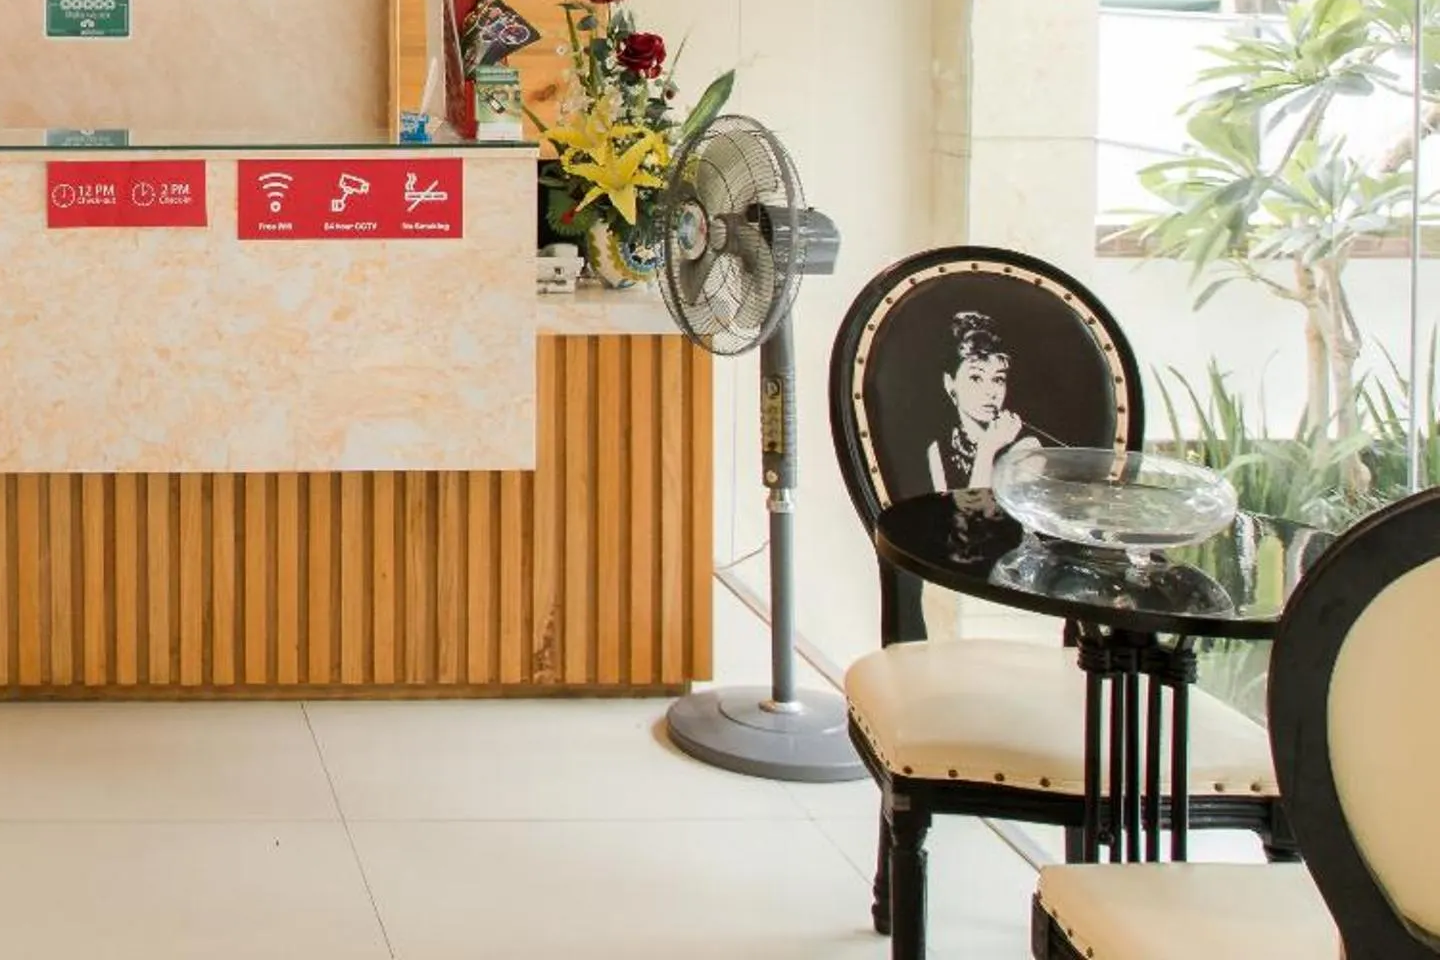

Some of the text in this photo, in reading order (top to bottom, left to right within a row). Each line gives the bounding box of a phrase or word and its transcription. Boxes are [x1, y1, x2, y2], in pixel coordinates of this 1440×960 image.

[79, 184, 114, 196] 12 PM
[161, 184, 189, 195] 2 PM
